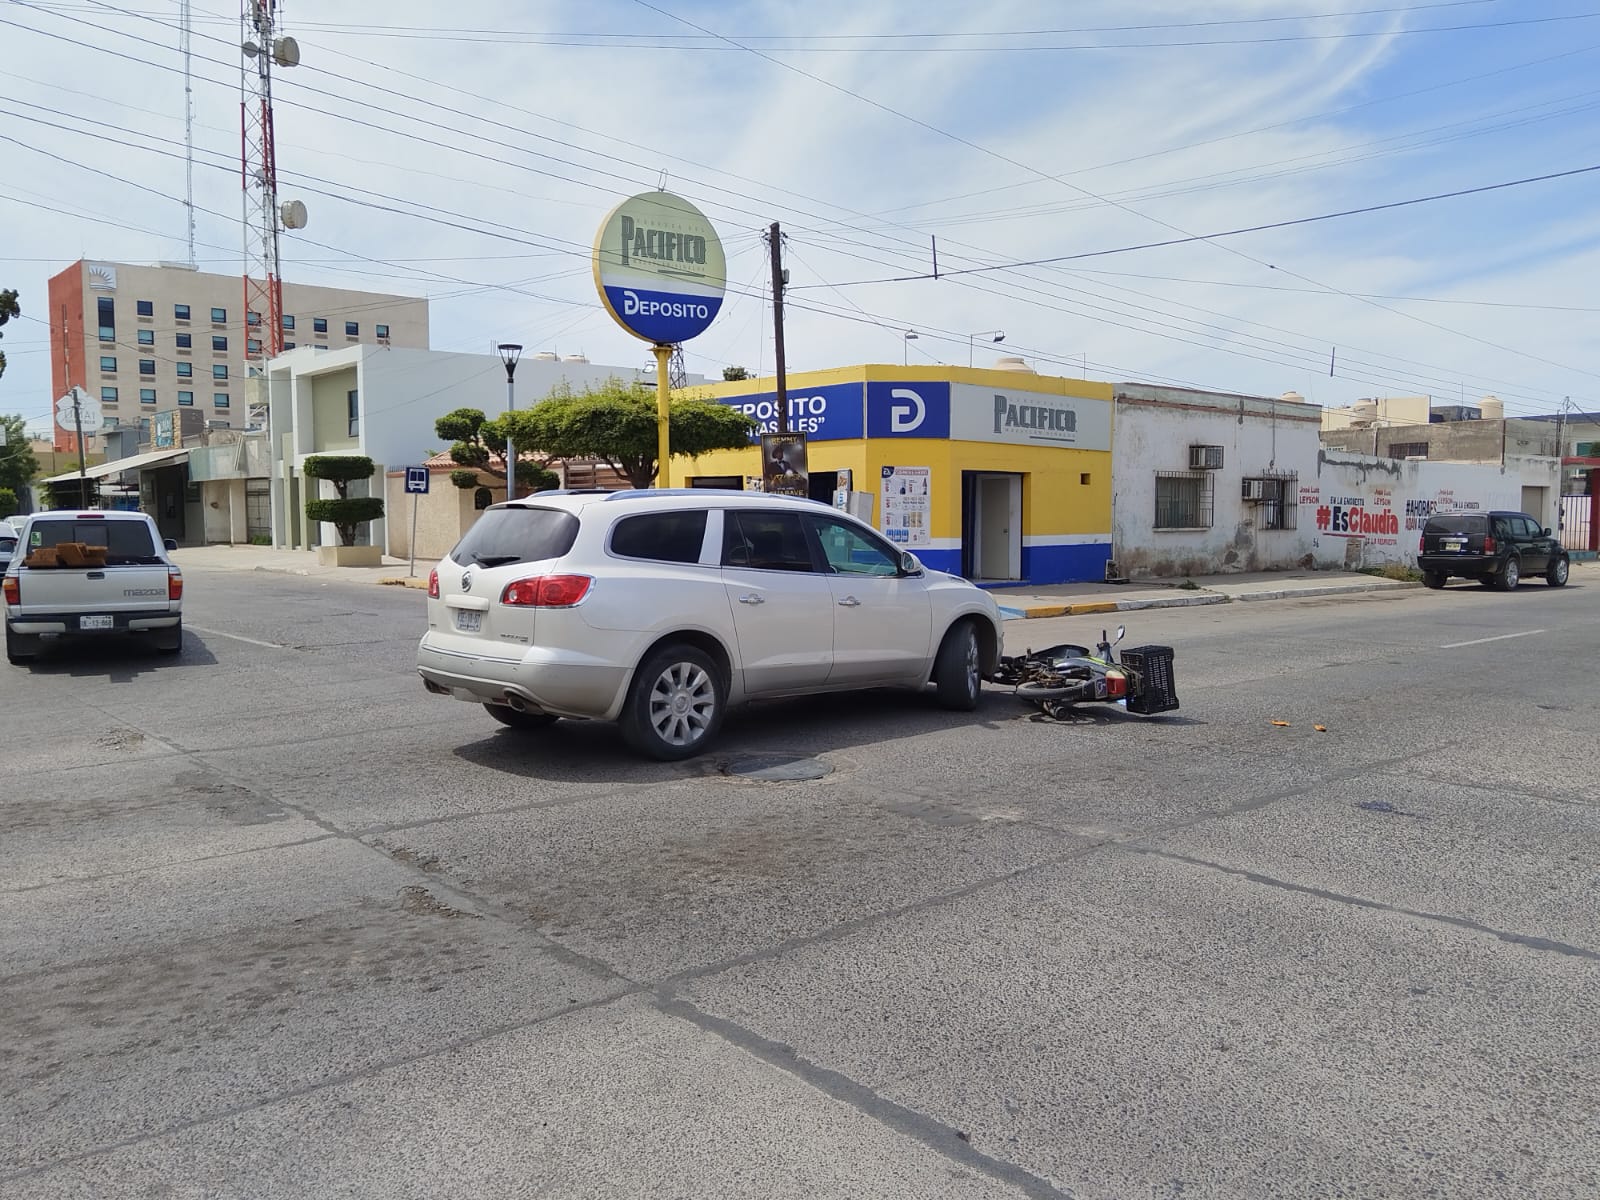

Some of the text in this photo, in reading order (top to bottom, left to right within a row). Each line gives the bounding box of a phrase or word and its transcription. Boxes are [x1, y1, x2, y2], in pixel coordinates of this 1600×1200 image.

[621, 215, 706, 266] PACIFICO
[624, 291, 708, 319] DEPOSITO
[993, 394, 1077, 434] PACIFICO
[1299, 496, 1320, 504] LEYSON
[1316, 505, 1399, 535] #EsClaudia
